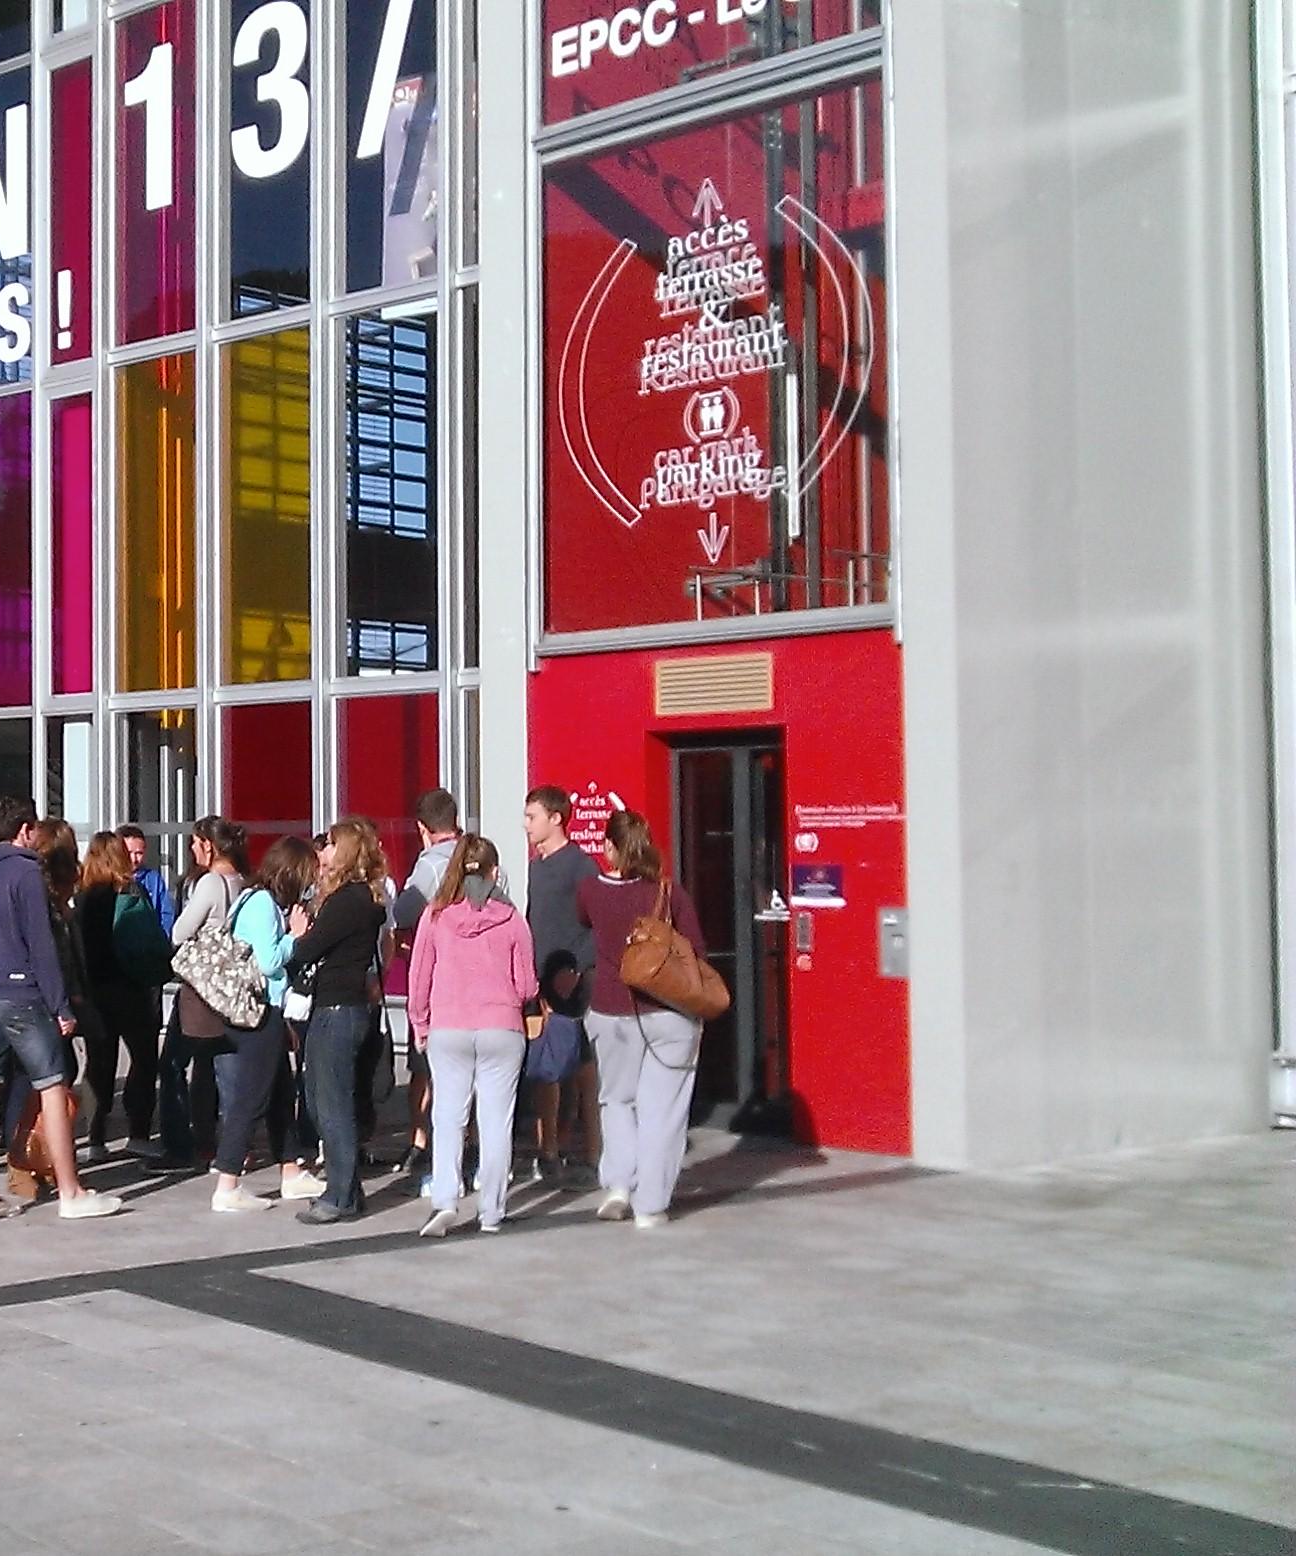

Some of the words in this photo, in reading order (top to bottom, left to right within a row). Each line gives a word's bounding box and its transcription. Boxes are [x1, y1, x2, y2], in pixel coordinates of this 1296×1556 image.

[552, 0, 680, 77] EPCC
[668, 214, 750, 258] accès
[655, 255, 764, 301] terrasse
[699, 300, 733, 331] &
[639, 321, 789, 378] restaurant
